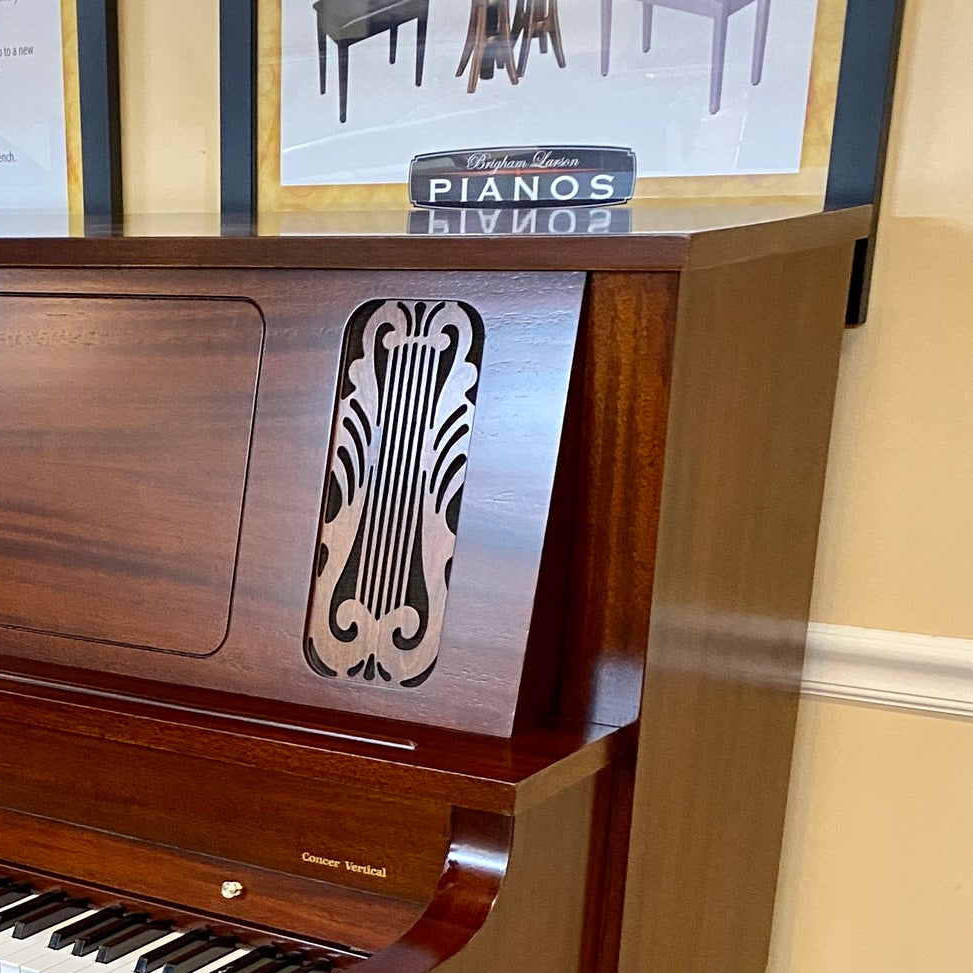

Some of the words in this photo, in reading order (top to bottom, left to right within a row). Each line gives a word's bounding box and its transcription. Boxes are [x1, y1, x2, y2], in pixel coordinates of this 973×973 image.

[4, 47, 12, 57] to
[12, 47, 17, 56] a
[18, 45, 34, 55] new
[466, 152, 527, 175] Brigham
[530, 150, 580, 168] Larson
[429, 174, 615, 203] PIANOS
[302, 852, 340, 868] Concer
[344, 860, 387, 878] Vertical
